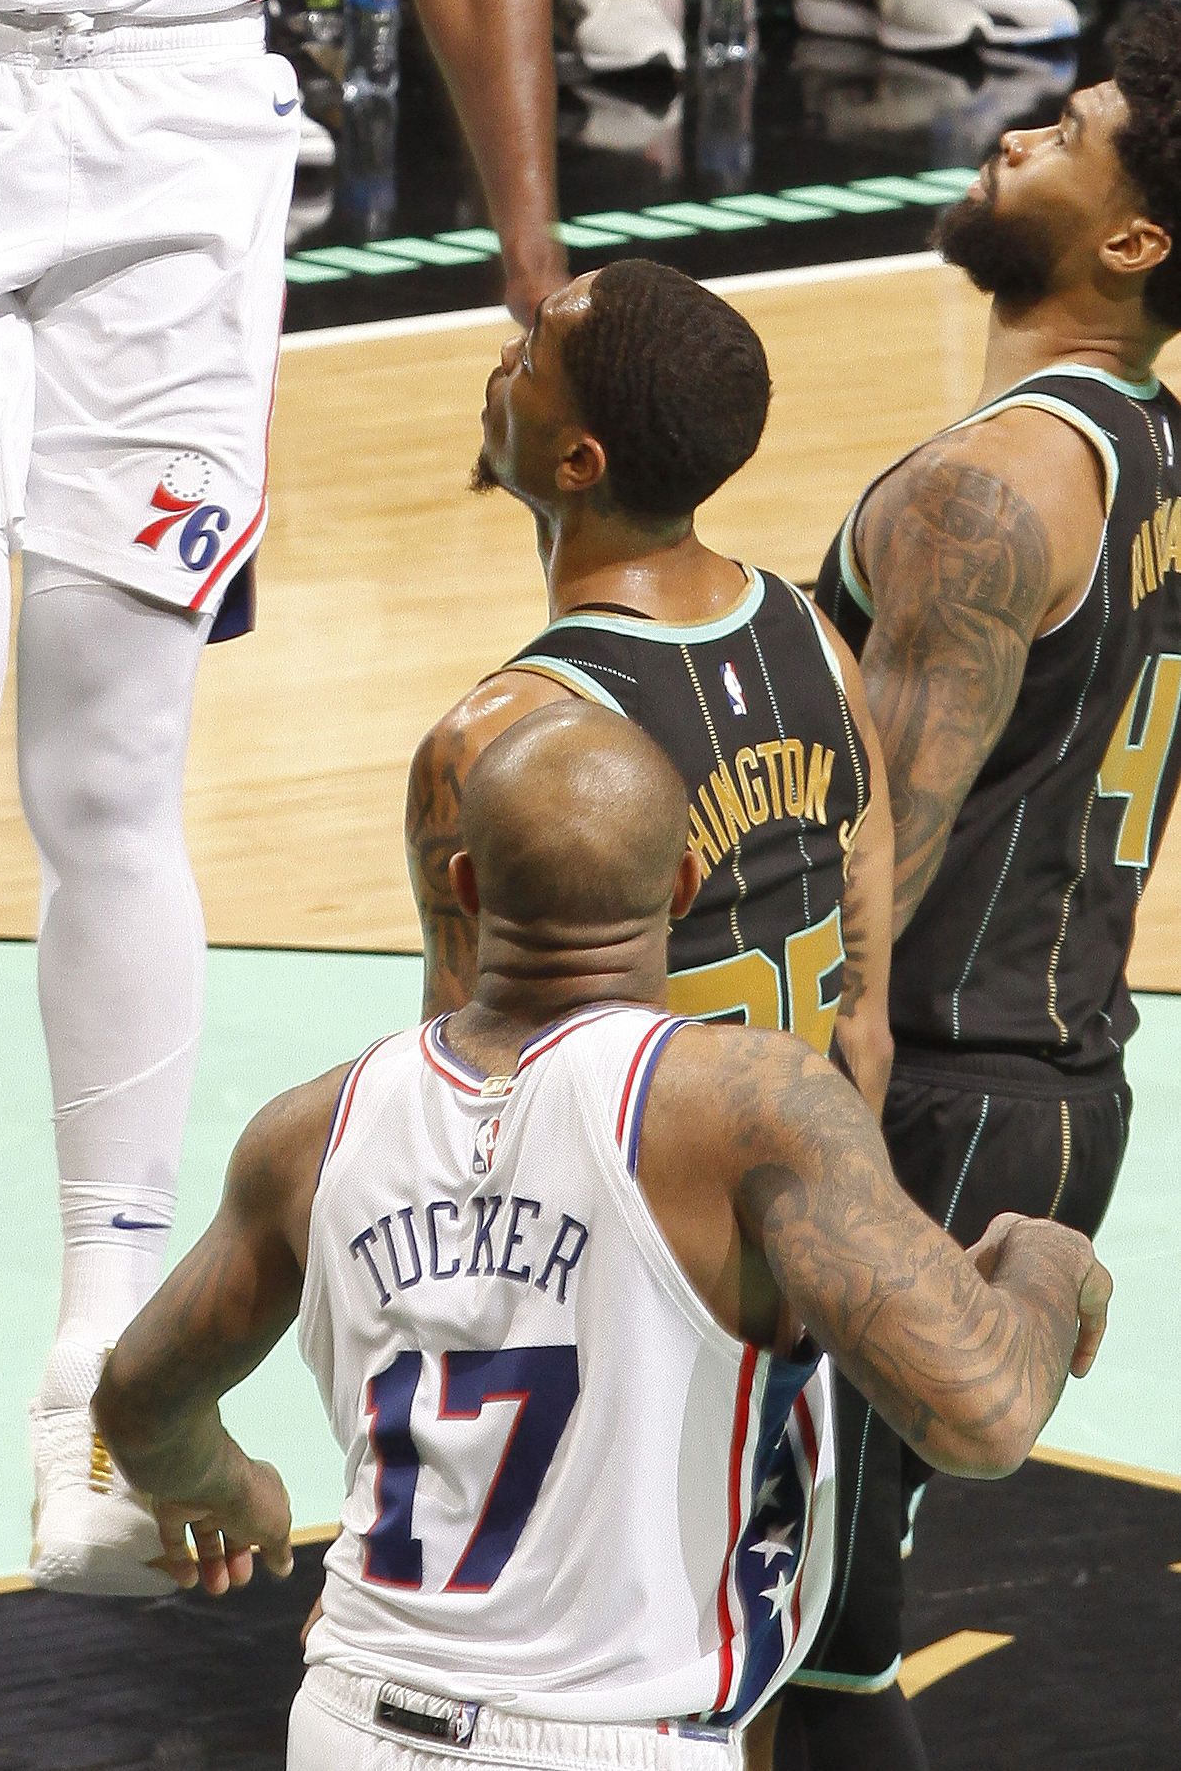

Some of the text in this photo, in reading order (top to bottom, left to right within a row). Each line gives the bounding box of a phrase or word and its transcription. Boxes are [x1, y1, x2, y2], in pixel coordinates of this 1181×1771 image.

[132, 477, 231, 571] 76
[687, 738, 835, 879] HINGTON
[1097, 653, 1181, 868] 4
[349, 1195, 589, 1308] TUCKER
[360, 1344, 580, 1594] 17
